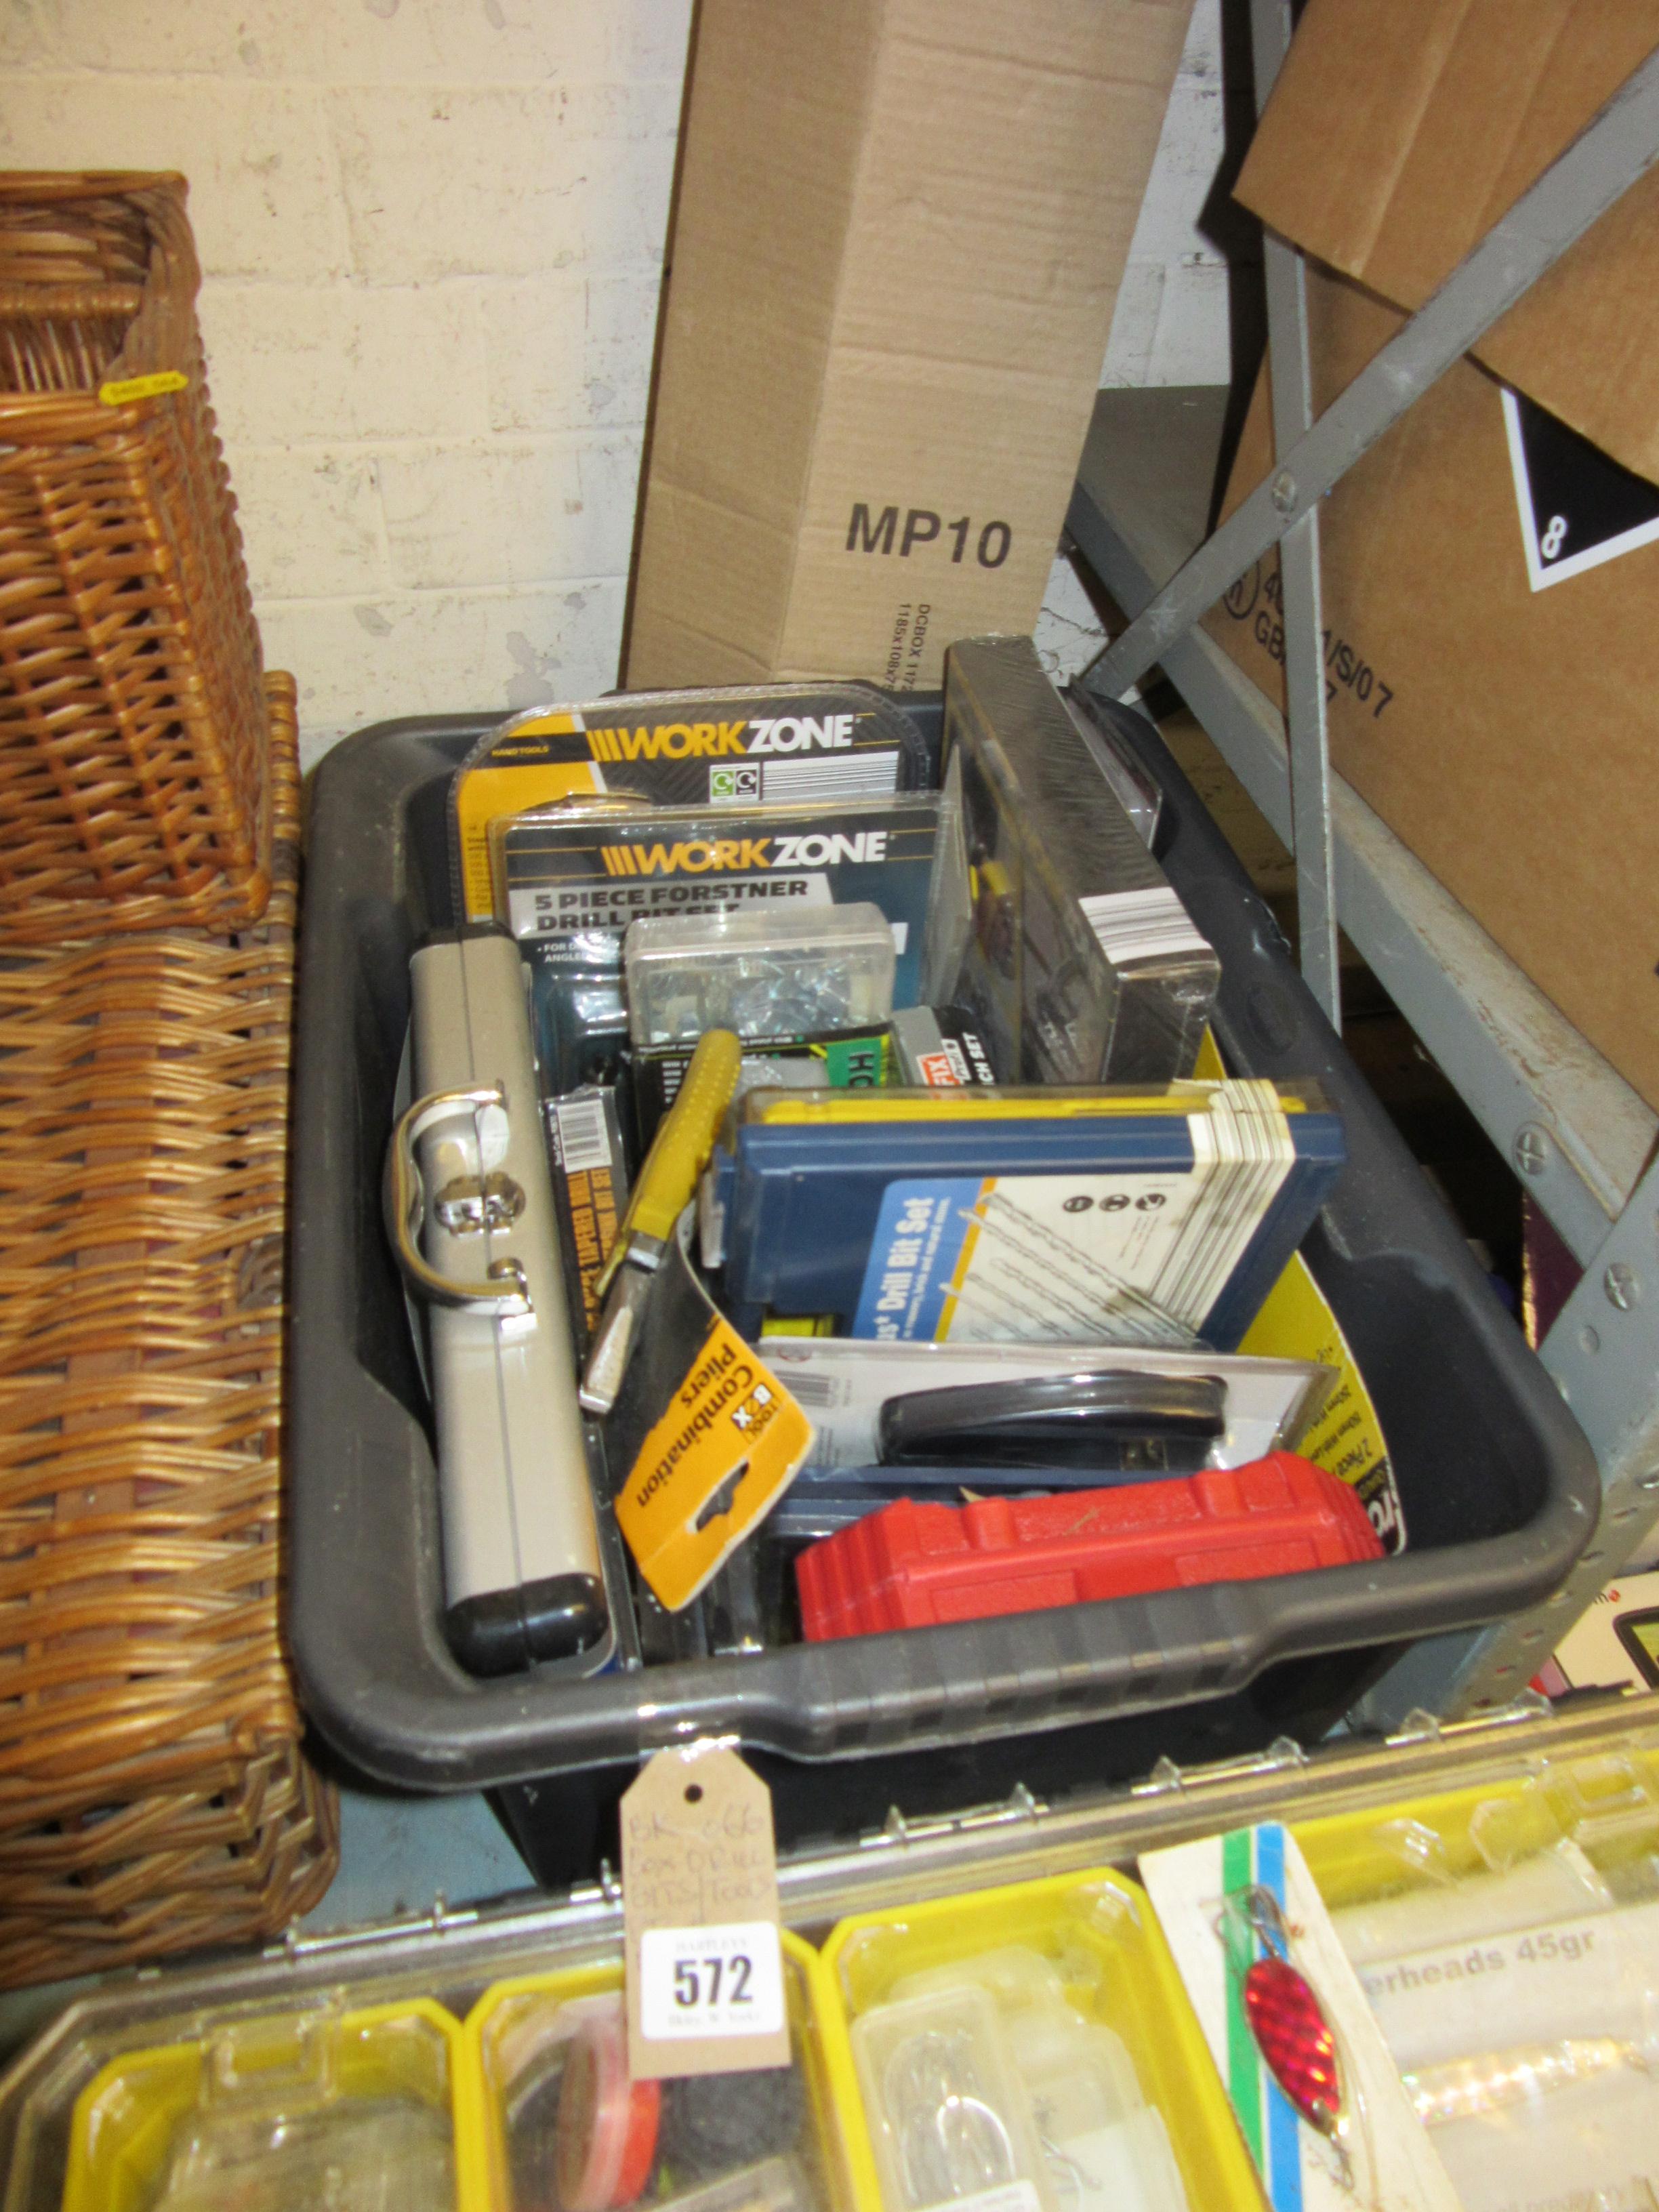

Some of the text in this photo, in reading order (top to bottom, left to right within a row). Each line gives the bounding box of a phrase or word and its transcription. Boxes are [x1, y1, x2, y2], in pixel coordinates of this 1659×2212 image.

[846, 502, 1012, 569] MP10
[1540, 515, 1568, 559] 8
[909, 604, 931, 657] DCBOX
[617, 714, 855, 760] WORKZONE
[632, 831, 888, 876] WORKZONE
[534, 880, 808, 911] 5 PIECE FORSTNER
[537, 910, 625, 932] DRILL
[962, 1031, 986, 1060] SET
[895, 1197, 935, 1235] Set
[886, 1238, 923, 1268] Bit
[876, 1271, 914, 1311] Drill
[680, 1342, 737, 1408] Pliers
[637, 1364, 754, 1507] Combination
[1517, 1929, 1595, 1961] 45gr
[674, 1953, 753, 2007] 572
